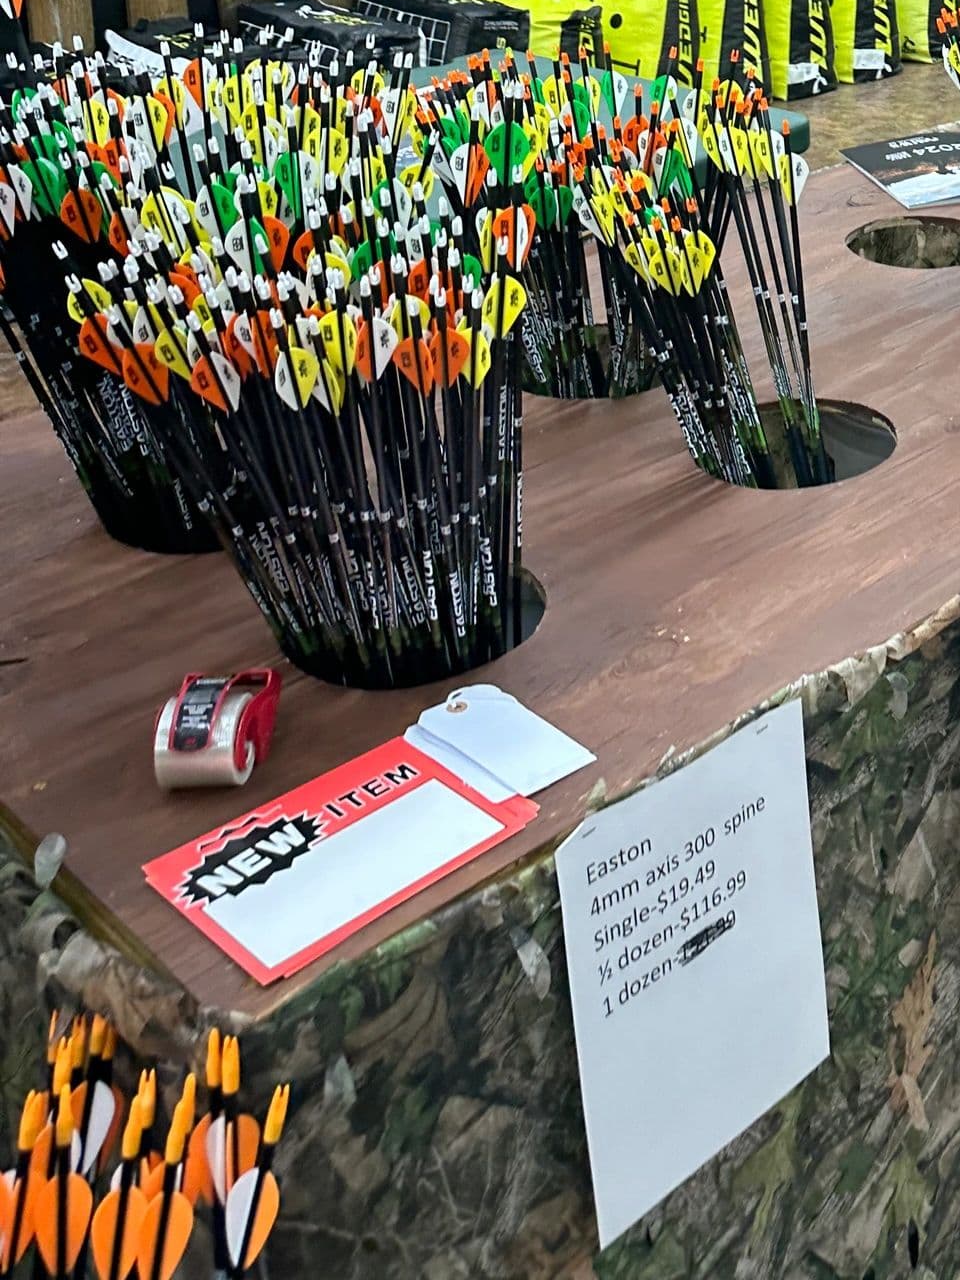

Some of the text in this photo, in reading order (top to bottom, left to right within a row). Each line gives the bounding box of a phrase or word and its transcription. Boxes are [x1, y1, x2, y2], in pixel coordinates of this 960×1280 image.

[668, 393, 698, 459] EASTON
[422, 550, 438, 621] EASTON
[449, 571, 466, 637] EASTON
[480, 537, 497, 607] EASTON
[195, 763, 420, 897] NEW ITEM
[586, 837, 653, 886] Easton
[590, 795, 766, 917] 4mm axis 300 spine
[595, 859, 716, 953] Single-$19.49
[618, 869, 747, 971] dozen-$116.99
[603, 996, 613, 1019] 1
